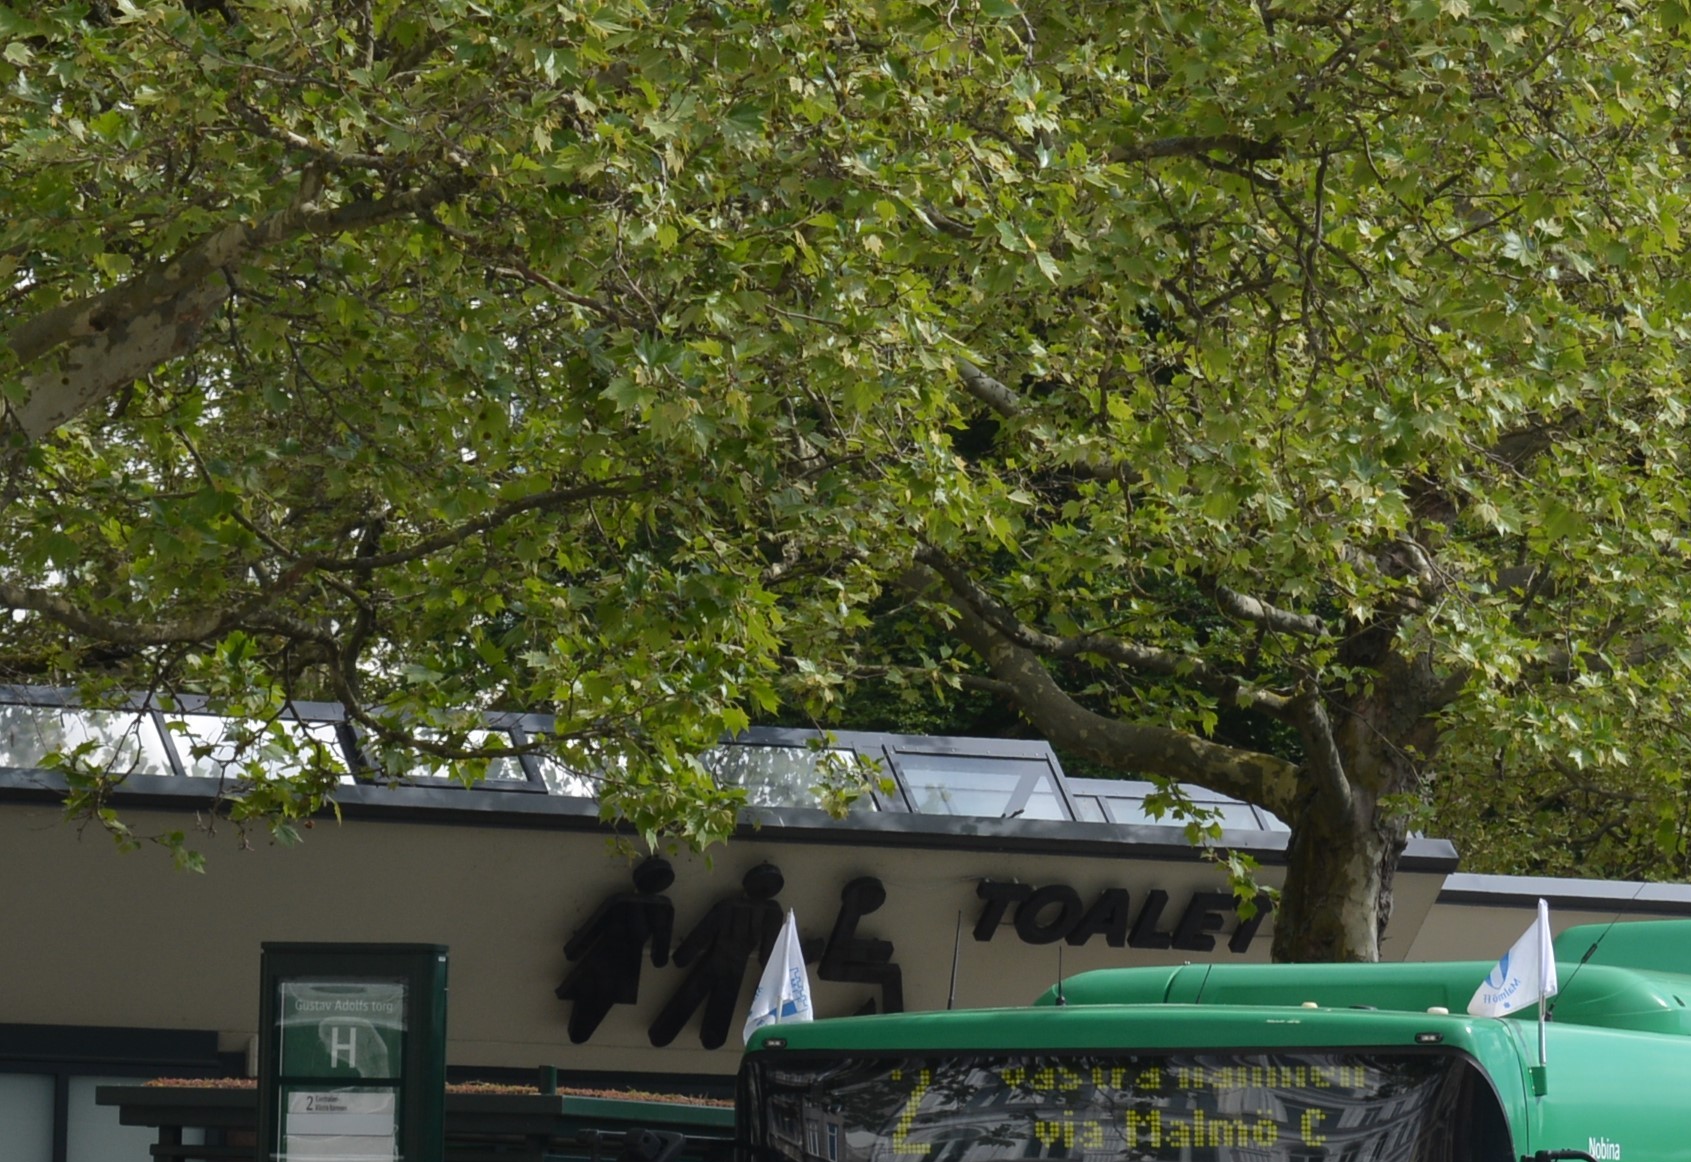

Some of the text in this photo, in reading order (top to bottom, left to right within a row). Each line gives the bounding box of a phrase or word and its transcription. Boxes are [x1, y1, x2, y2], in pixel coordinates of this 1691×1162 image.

[295, 1000, 393, 1014] Gustav Adolfs torg
[331, 1027, 357, 1068] H
[306, 1095, 314, 1111] 2
[892, 1068, 931, 1154] 2
[1035, 1108, 1327, 1148] via Malmö C
[1588, 1136, 1620, 1160] Nobina
